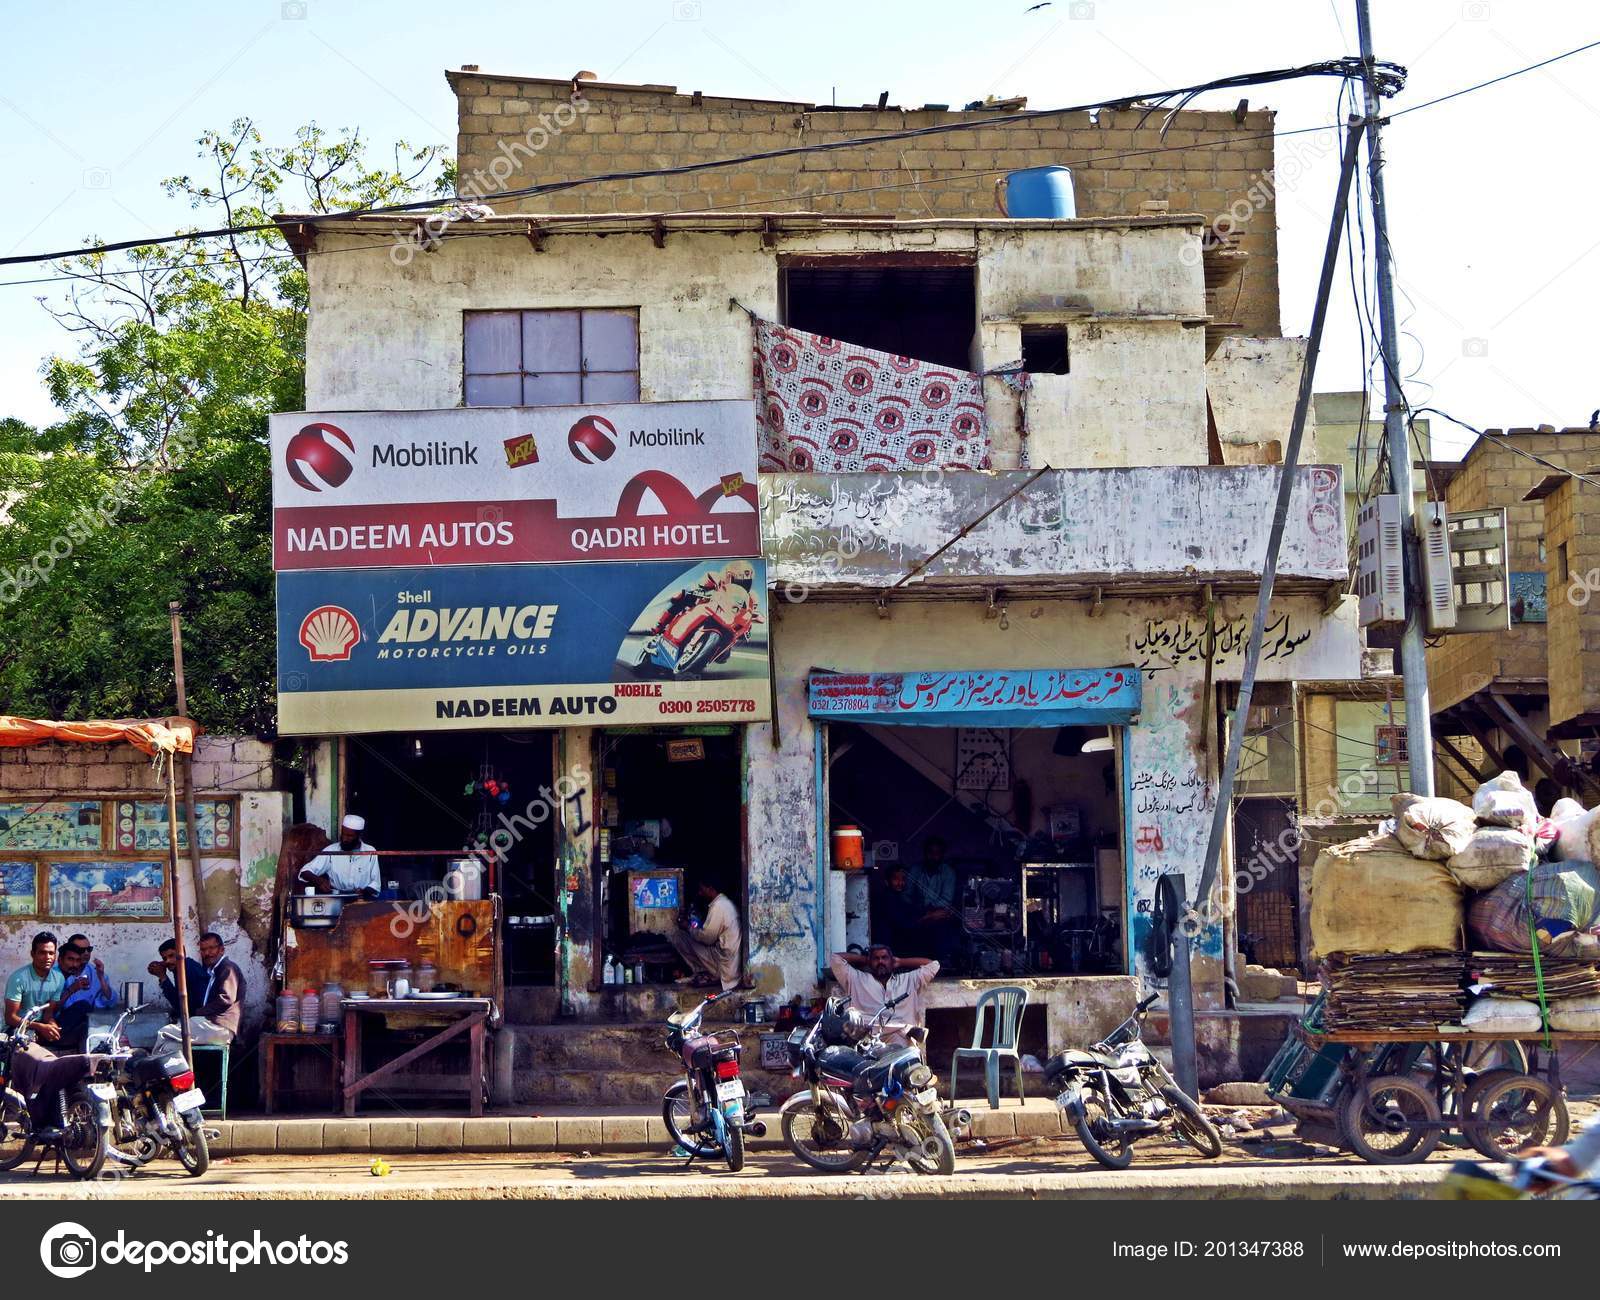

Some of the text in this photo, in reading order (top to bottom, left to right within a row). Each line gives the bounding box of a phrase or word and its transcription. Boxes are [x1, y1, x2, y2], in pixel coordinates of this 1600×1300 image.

[629, 428, 705, 448] Mobilink
[372, 441, 478, 468] Mobilink
[287, 521, 514, 552] NADEEM AUTOS
[571, 524, 730, 552] QADRI HOTEL
[397, 590, 431, 604] Shell
[377, 604, 559, 644] ADVANCE
[377, 644, 548, 660] MOTORCYCLE OILS
[614, 685, 662, 697] MOBILE
[436, 696, 617, 719] NADEEM AUTO
[659, 700, 755, 713] 0300 2505778
